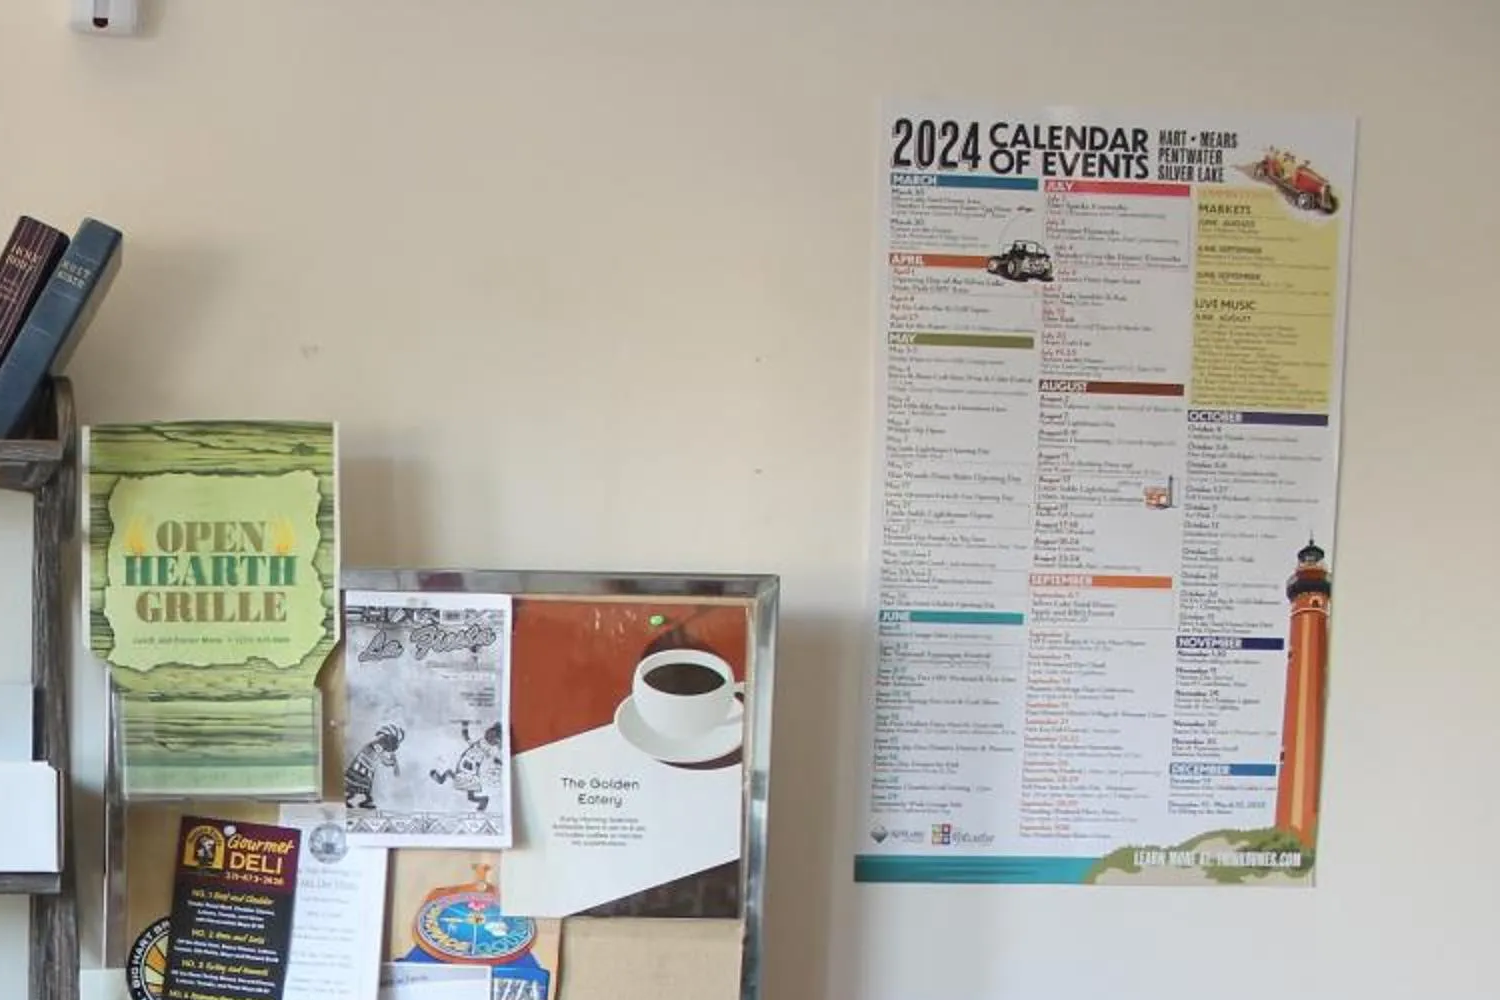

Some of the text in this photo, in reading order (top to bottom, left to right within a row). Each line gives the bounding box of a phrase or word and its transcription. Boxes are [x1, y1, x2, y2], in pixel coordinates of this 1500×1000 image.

[892, 118, 981, 170] 2024
[989, 122, 1149, 153] CALENDAR
[1158, 129, 1238, 149] HART MEARS
[1157, 147, 1224, 165] PENTWATER
[989, 149, 1150, 179] OF EVENTS
[891, 175, 937, 188] MARCH
[1157, 165, 1224, 183] SILVER LAKE
[1045, 180, 1075, 194] JULY
[1198, 204, 1252, 215] MARKETS
[889, 253, 925, 268] APRIL
[1195, 299, 1257, 311] LIVE MUSIC
[887, 331, 918, 345] MAY
[1039, 380, 1087, 393] AUGUST
[1187, 410, 1244, 424] OCTOBER
[156, 519, 268, 554] OPEN
[123, 554, 300, 588] HEARTH
[1029, 574, 1093, 588] SEPTEMBER
[134, 590, 288, 624] GRILLE
[881, 610, 911, 624] JUNE
[1178, 637, 1244, 650] NOVEMBER
[1170, 763, 1232, 777] DECEMBER
[560, 777, 640, 791] The Golden
[578, 793, 623, 809] Eatery
[227, 832, 295, 855] Gourmet
[229, 851, 283, 875] DELI
